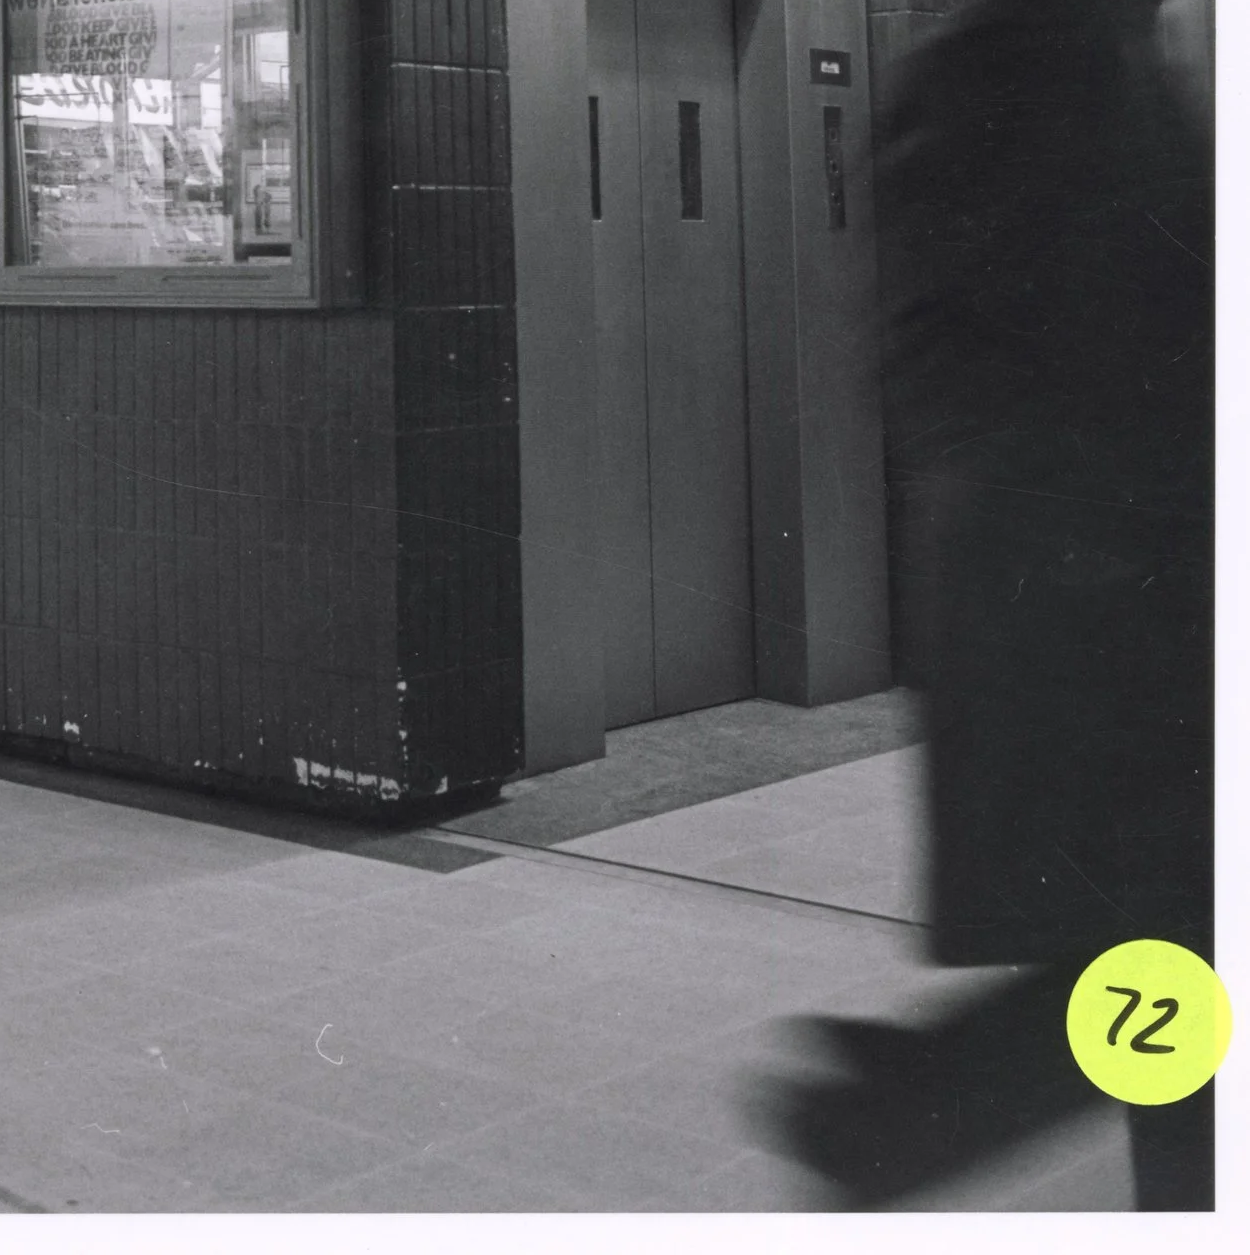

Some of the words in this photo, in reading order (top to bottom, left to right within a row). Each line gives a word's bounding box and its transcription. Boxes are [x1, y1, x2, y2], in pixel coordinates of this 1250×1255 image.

[81, 19, 114, 33] KEEP
[80, 33, 127, 47] HEART
[68, 47, 127, 62] BEATING
[91, 61, 138, 75] BLOOD
[1105, 985, 1179, 1054] 72
